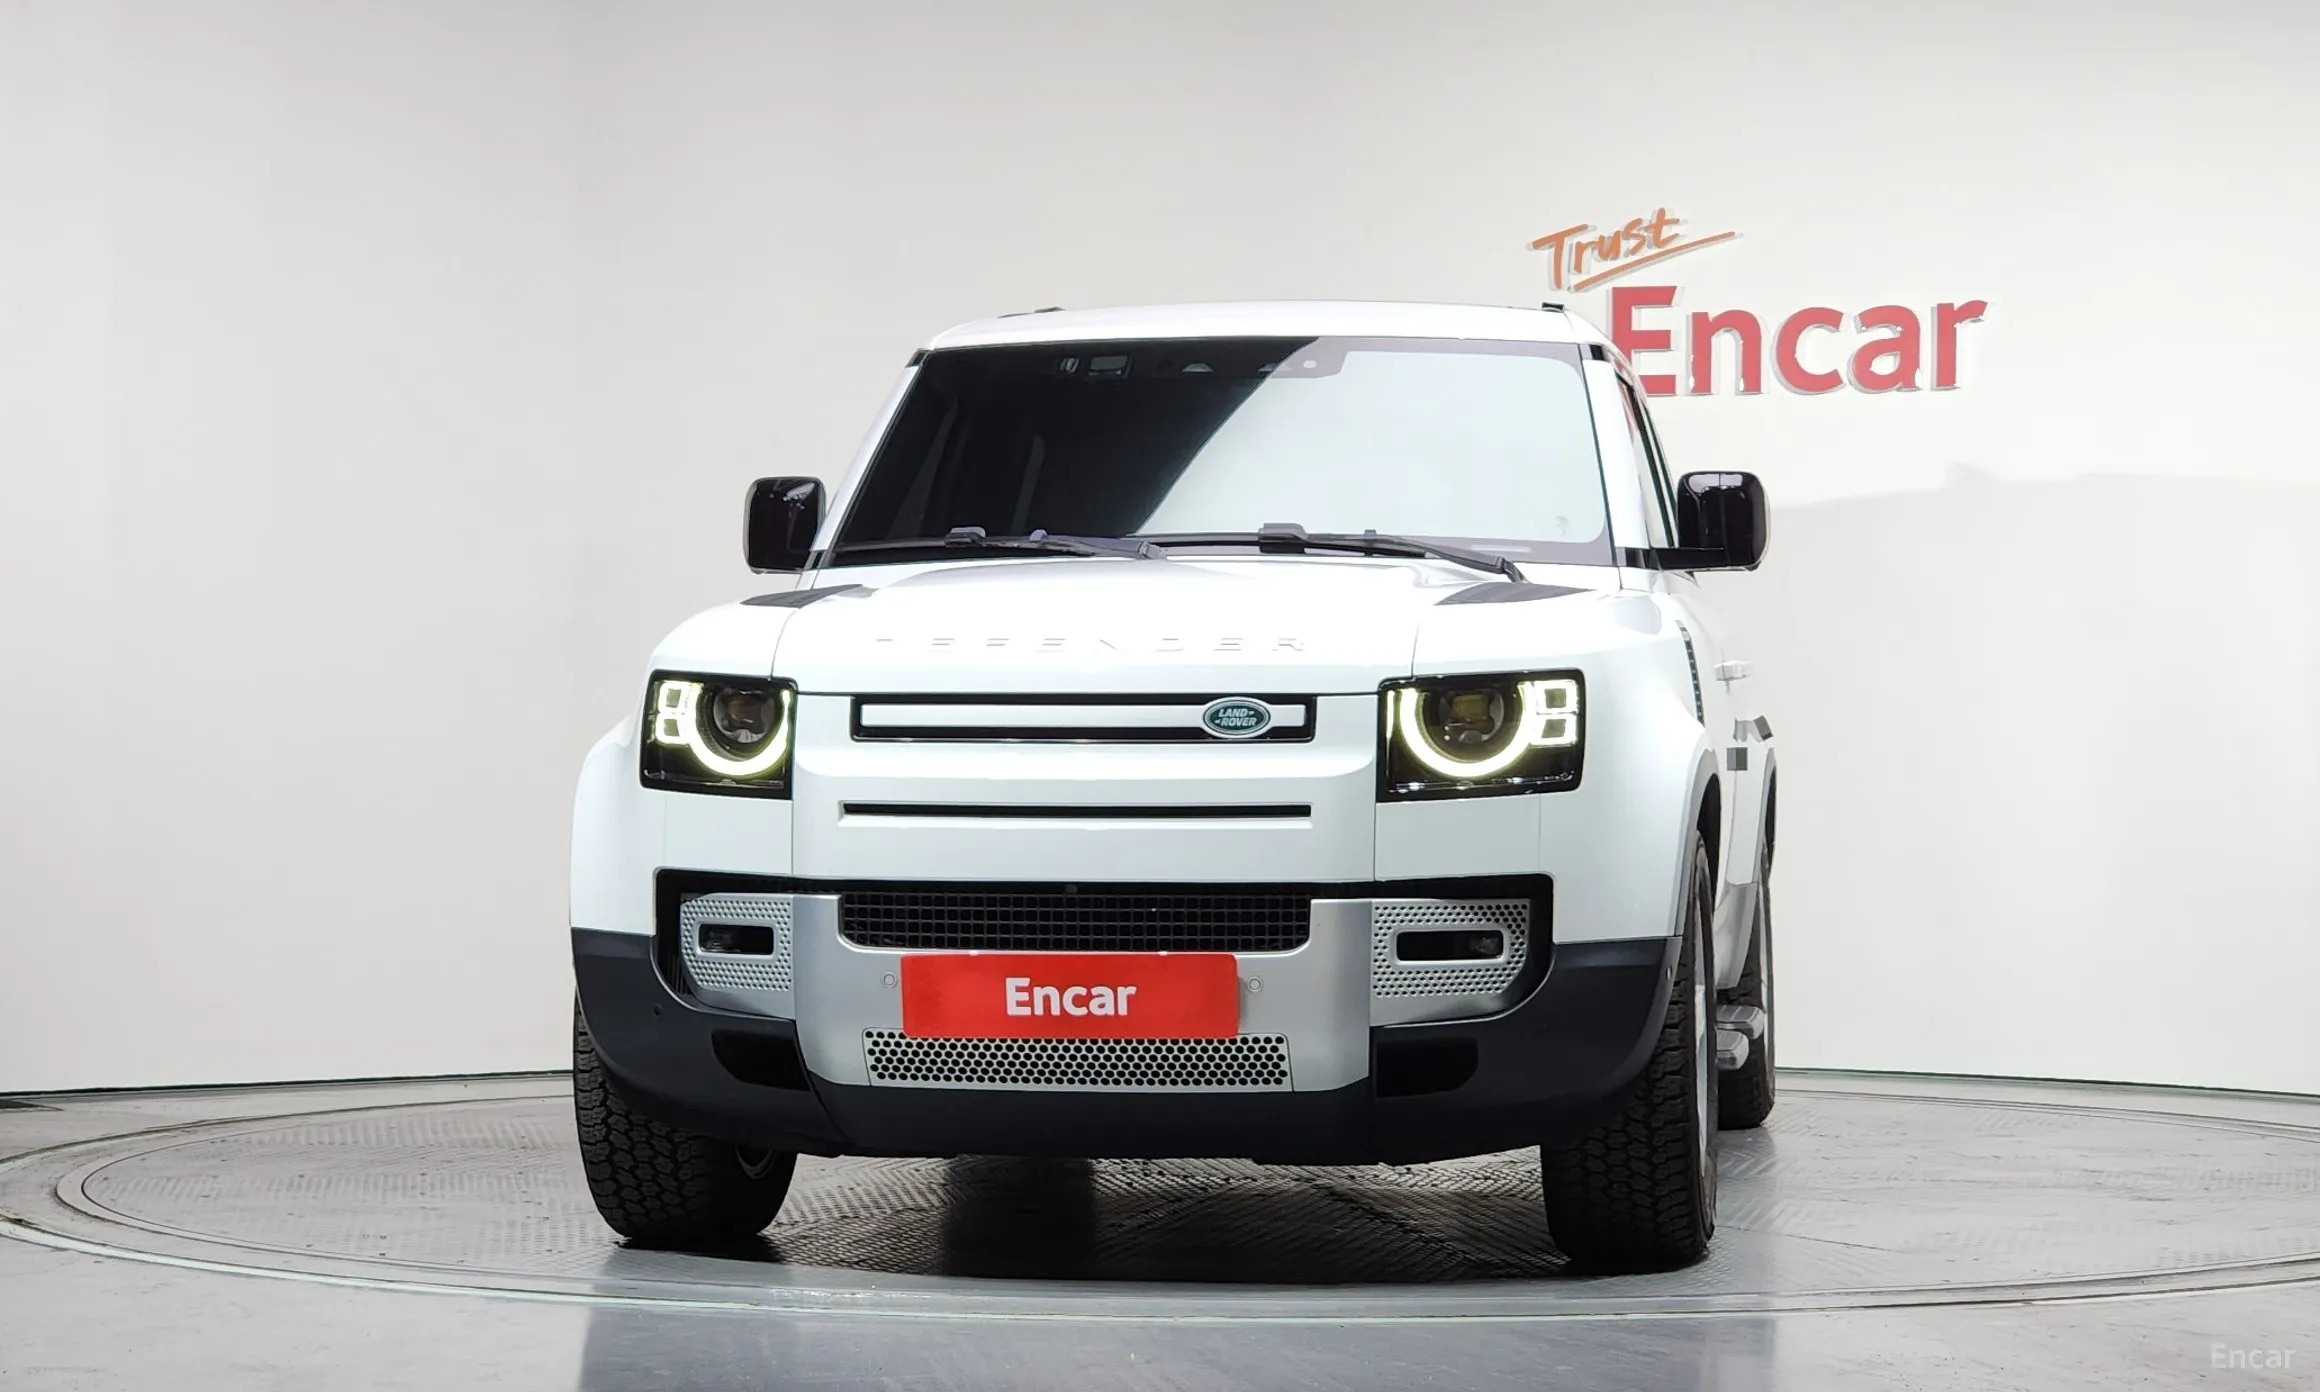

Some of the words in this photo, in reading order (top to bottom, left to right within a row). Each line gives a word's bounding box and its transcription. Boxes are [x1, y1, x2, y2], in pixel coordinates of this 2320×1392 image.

[1532, 207, 1680, 290] Trust
[1611, 285, 1988, 395] Encar
[872, 636, 1306, 653] EFENDER
[1218, 708, 1249, 717] LAND
[1220, 717, 1258, 727] ROVER
[1004, 977, 1137, 1017] Encar
